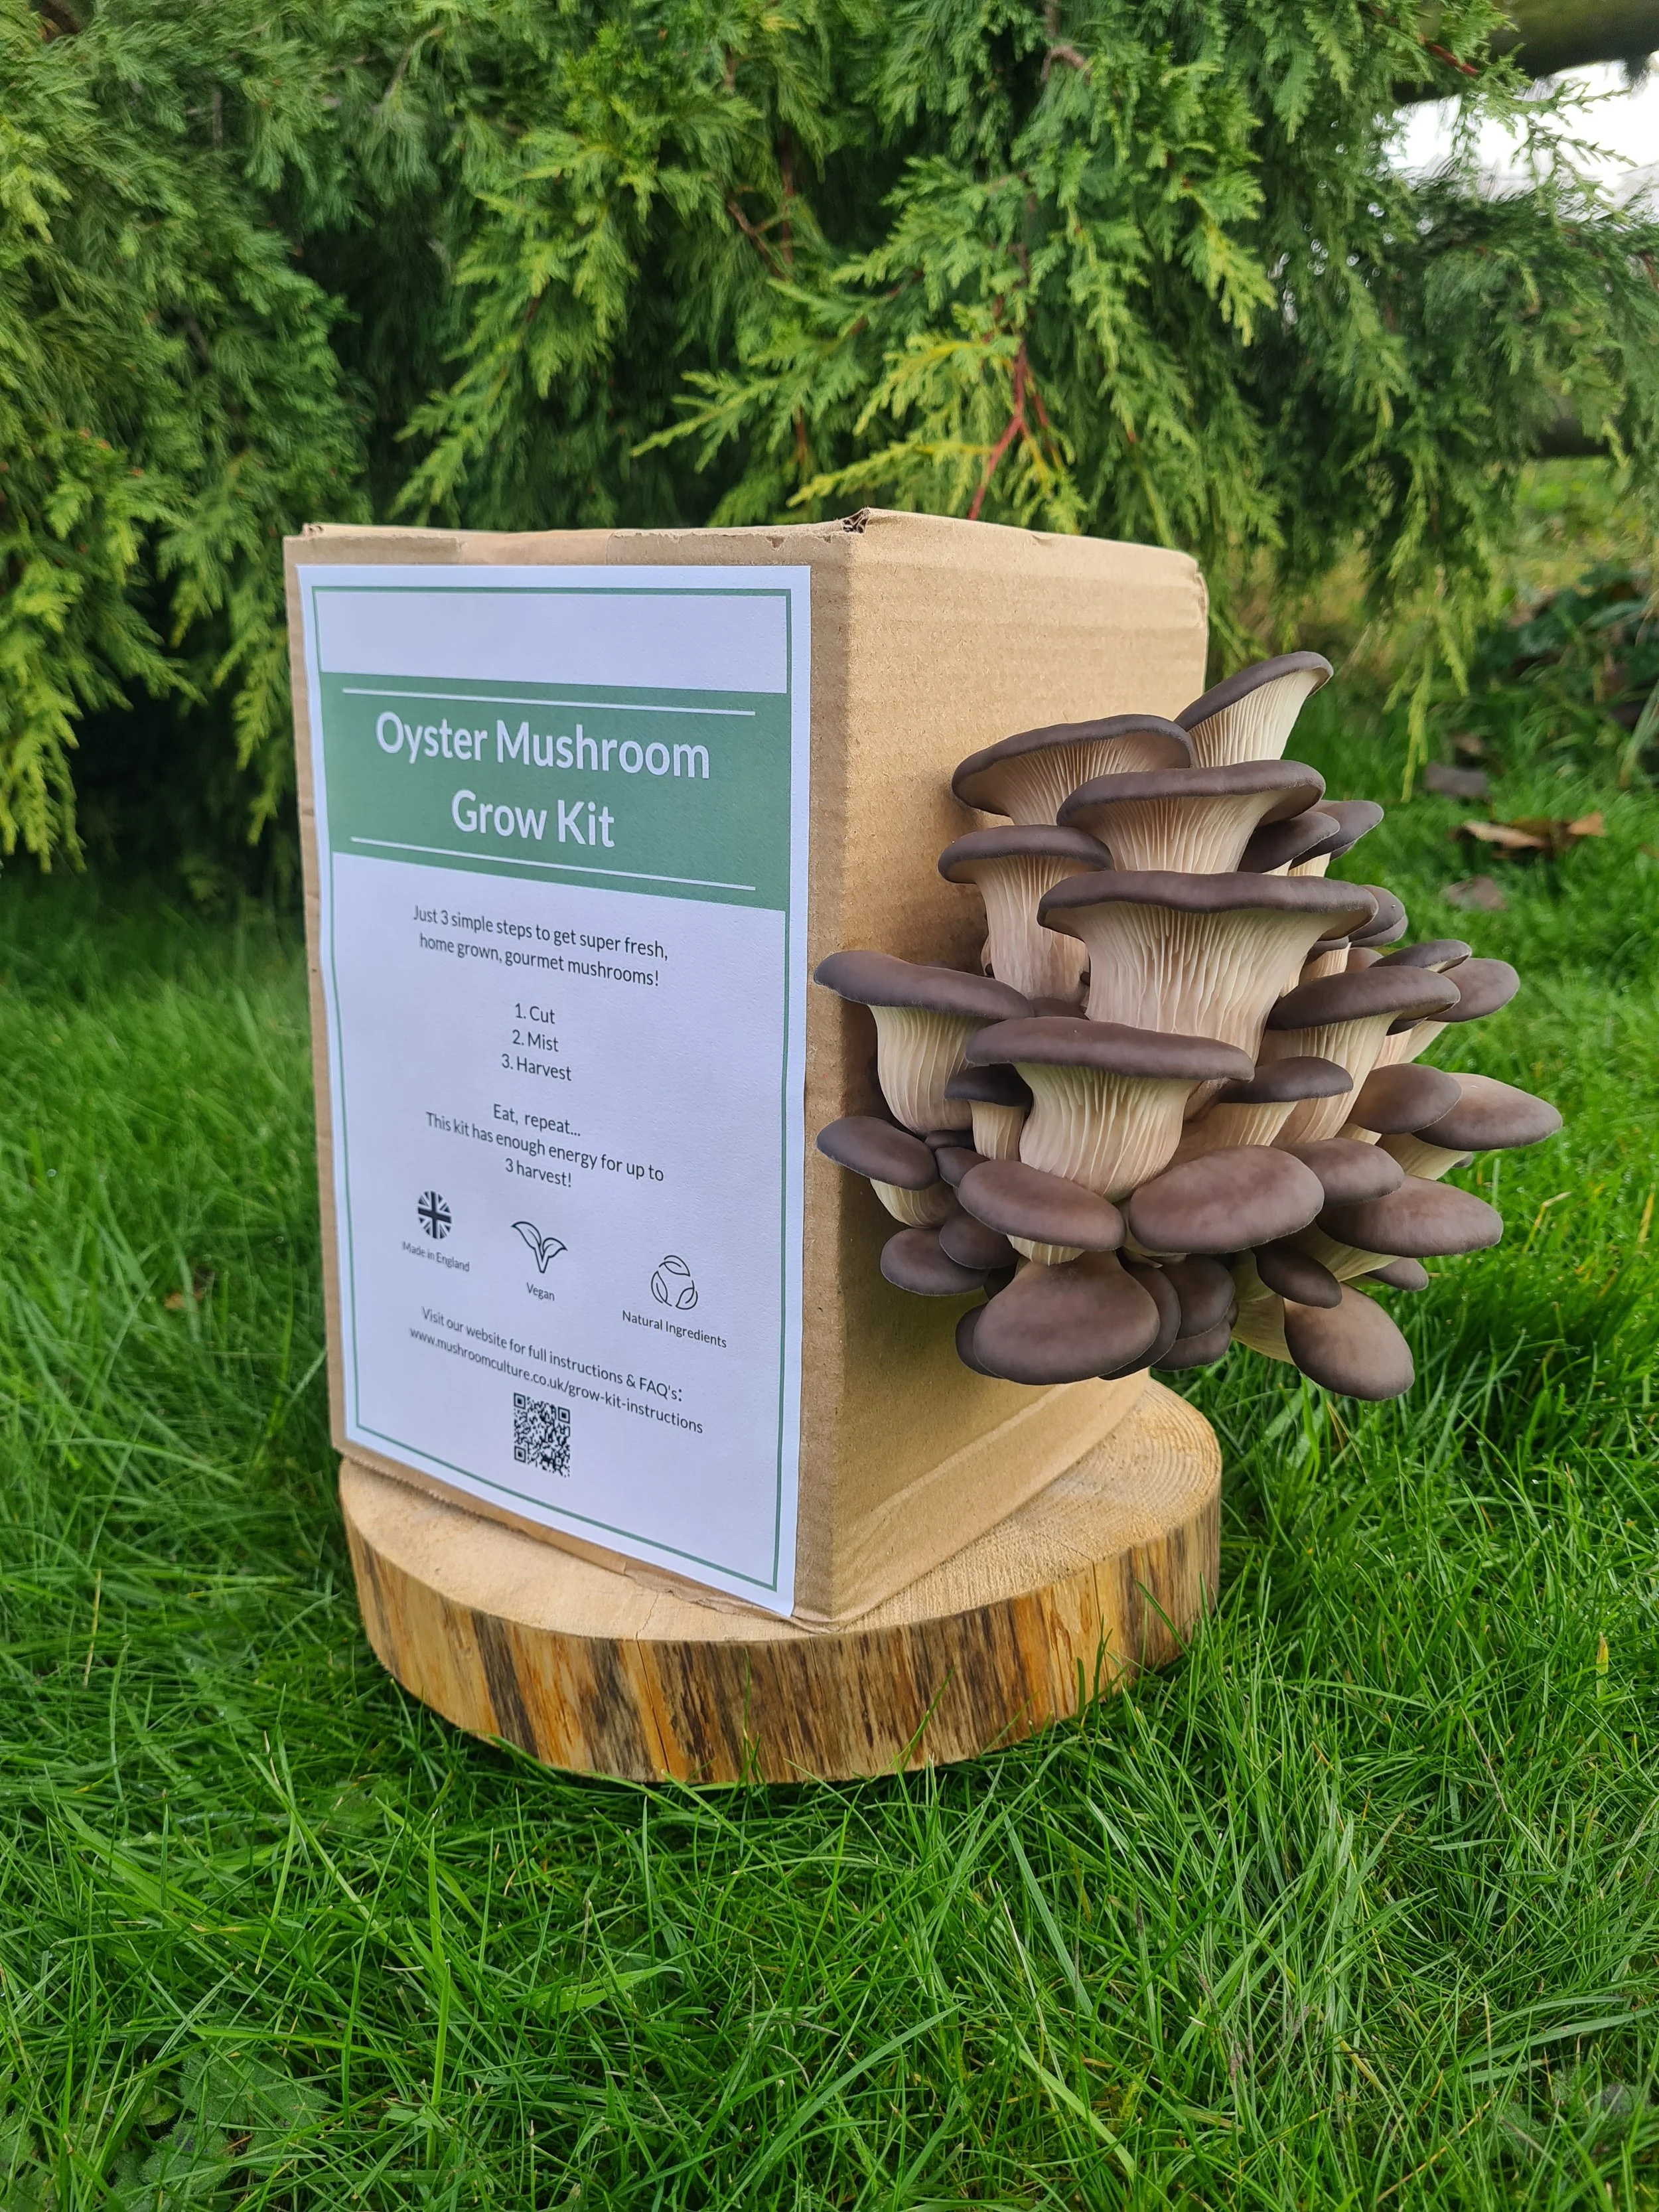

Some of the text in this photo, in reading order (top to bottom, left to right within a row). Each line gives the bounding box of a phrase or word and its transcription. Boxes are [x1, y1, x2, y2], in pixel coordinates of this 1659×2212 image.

[376, 711, 709, 779] Oyster Mushroom
[451, 789, 615, 849] Grow Kit
[413, 905, 668, 961] Just 3 simple steps to get super fresh,
[420, 932, 659, 987] home grown, gourmet mushrooms!
[515, 1003, 555, 1024] 1. Cut
[512, 1030, 559, 1053] 2. Mist
[502, 1054, 572, 1082] 3. Harvest
[493, 1104, 581, 1138] Eat, repeat...
[426, 1112, 664, 1181] This kit has enough energy for up to
[505, 1158, 572, 1187] 3 harvest!
[402, 1241, 470, 1272] Made in England
[526, 1282, 555, 1301] Vegan
[422, 1307, 445, 1327] Visit
[447, 1318, 464, 1333] our
[466, 1325, 507, 1349] website
[509, 1338, 526, 1355] for
[528, 1345, 546, 1362] full
[550, 1351, 623, 1384] instructions
[626, 1374, 636, 1388] &
[622, 1310, 727, 1349] Natural Ingredients
[409, 1328, 703, 1434] www.mushroomculture.co.uk/grow-kit-instructions
